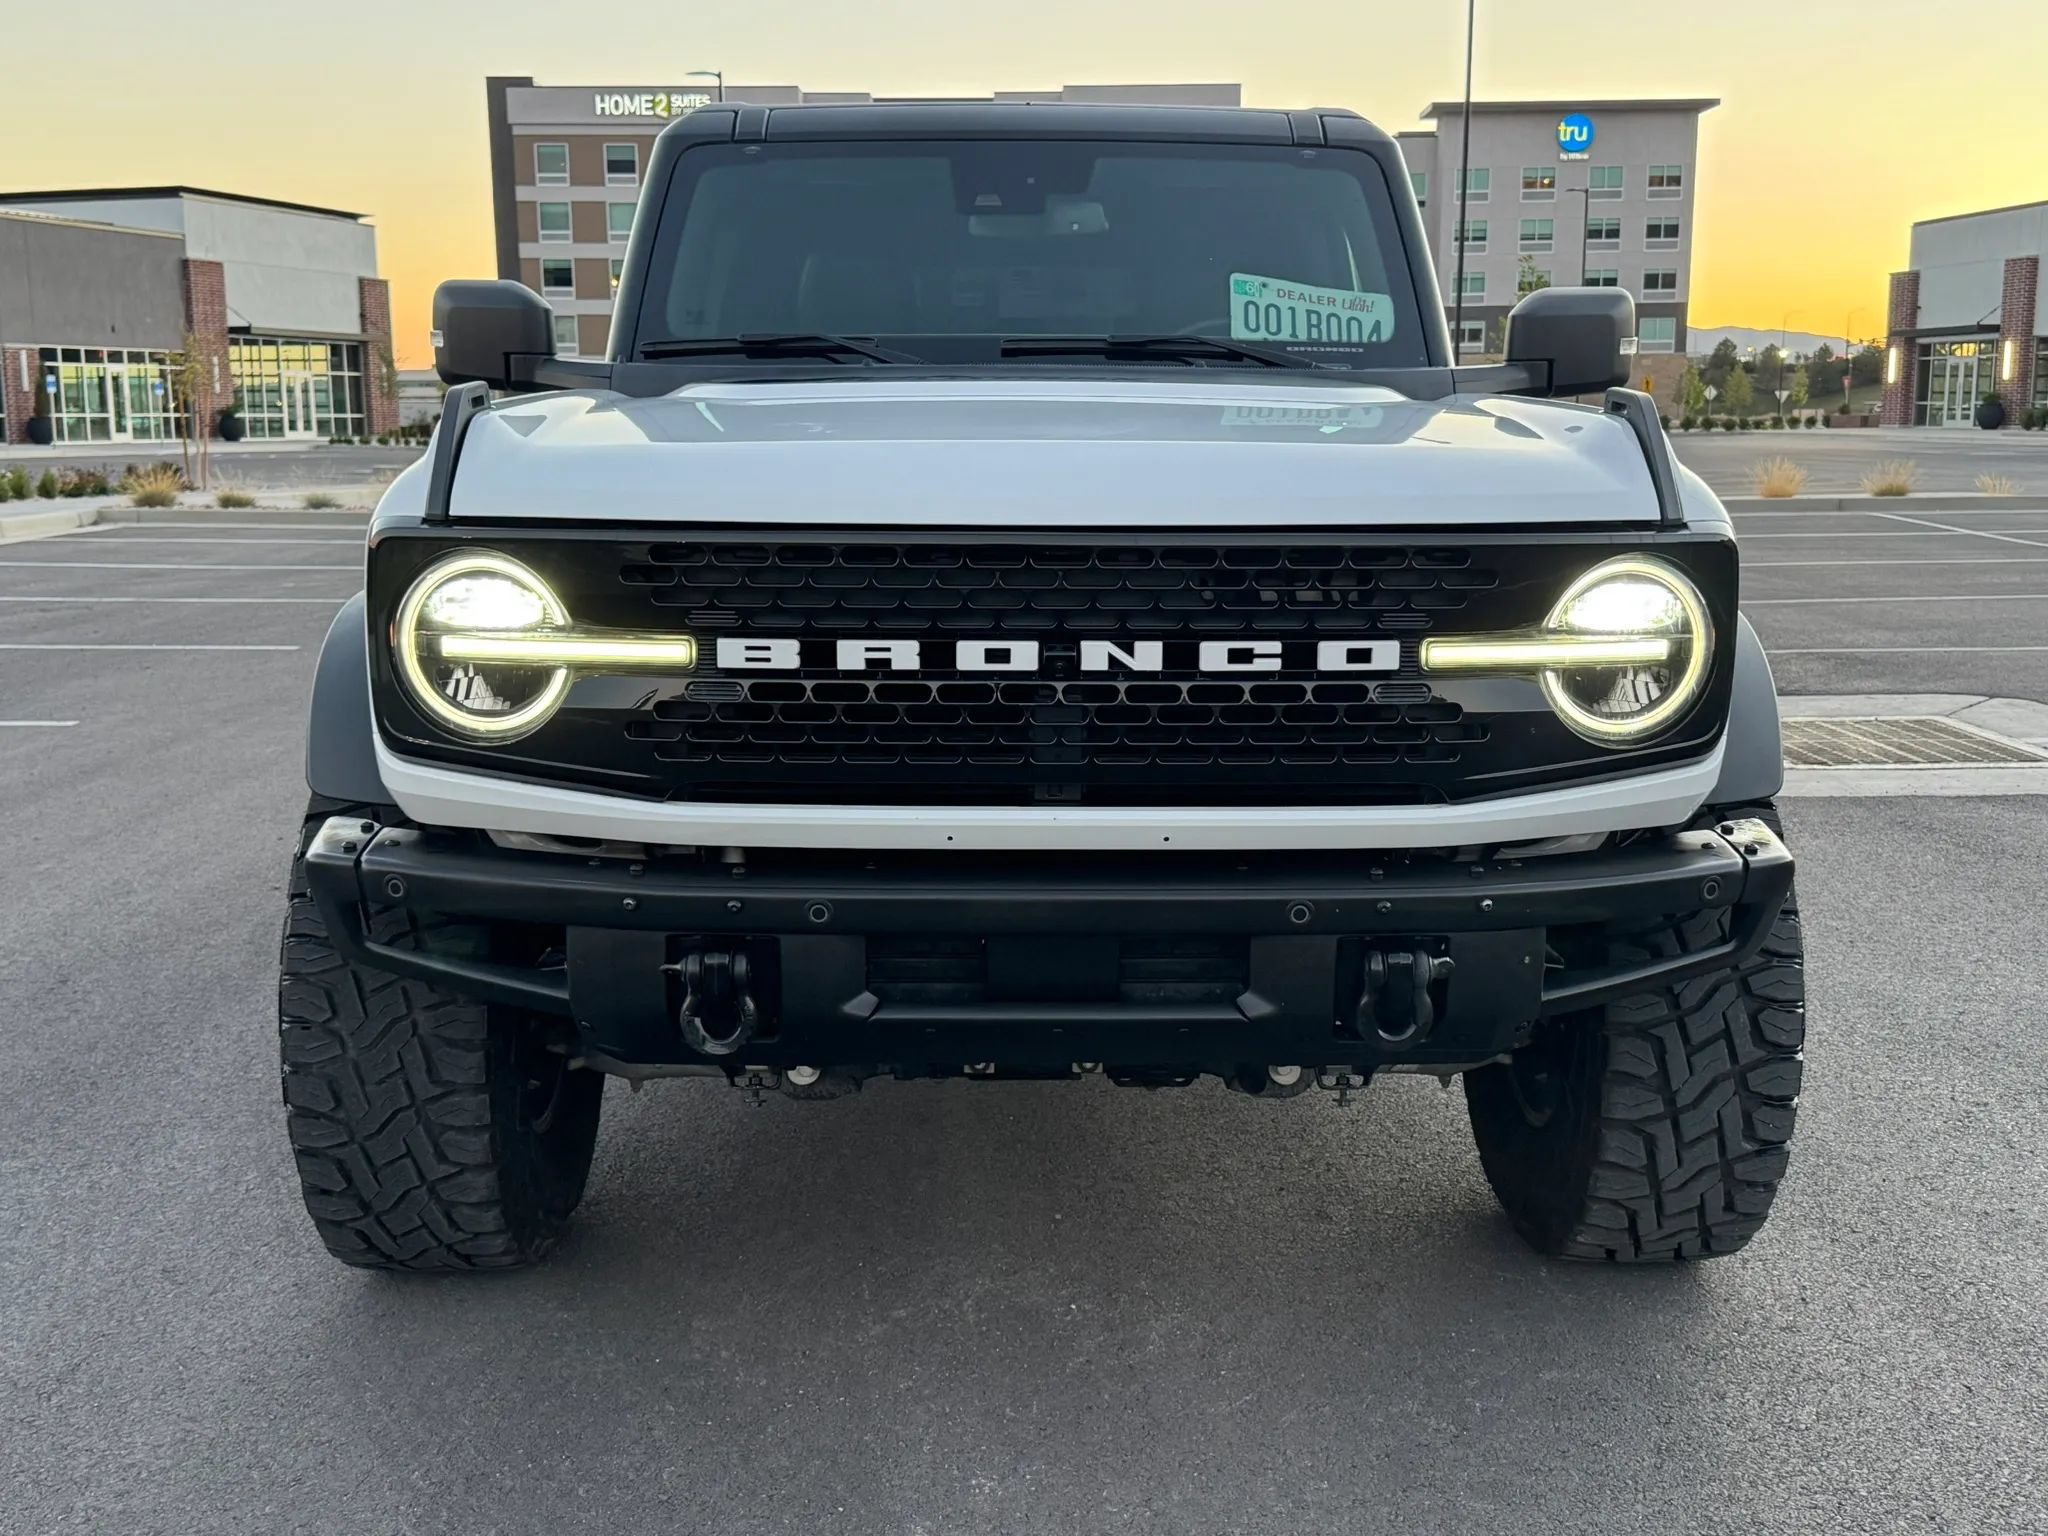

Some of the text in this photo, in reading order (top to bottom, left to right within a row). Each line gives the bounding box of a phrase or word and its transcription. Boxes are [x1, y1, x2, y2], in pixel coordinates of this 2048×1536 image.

[671, 93, 712, 108] SUITES
[1558, 121, 1588, 142] tru
[1277, 288, 1337, 307] DEALER
[716, 638, 1400, 671] BRONCO
